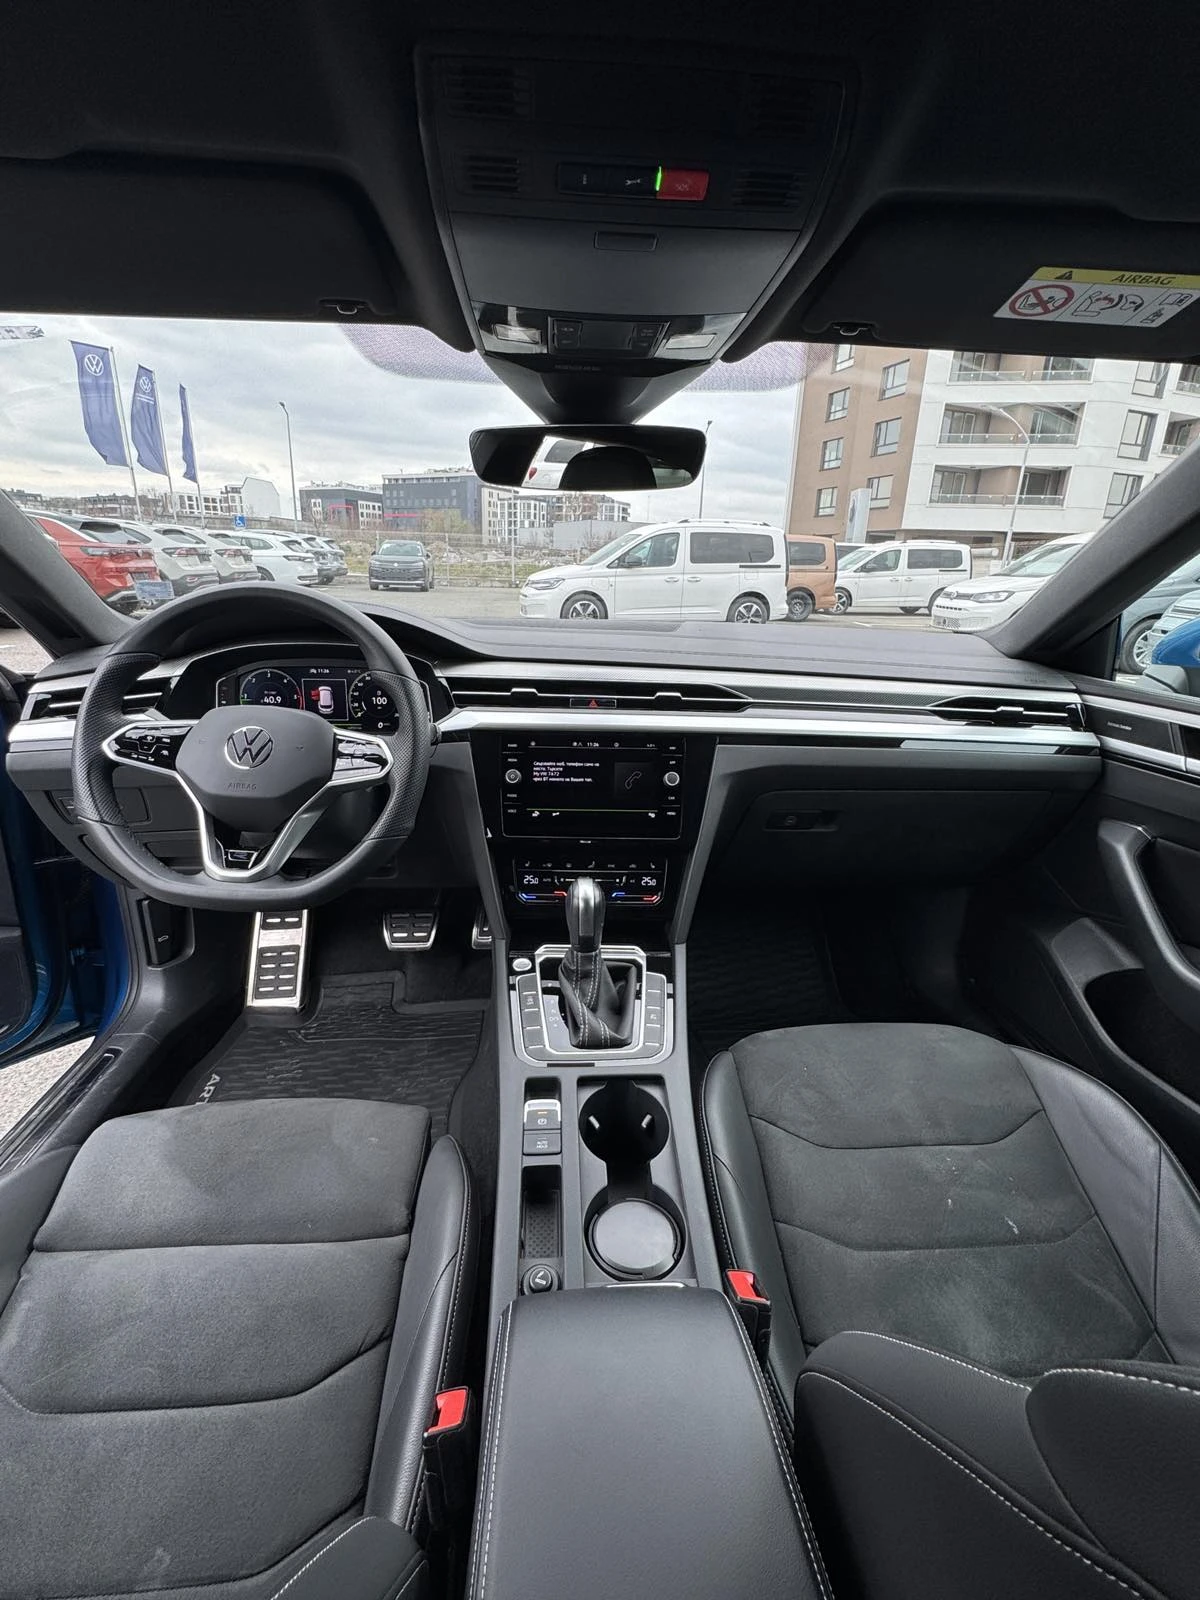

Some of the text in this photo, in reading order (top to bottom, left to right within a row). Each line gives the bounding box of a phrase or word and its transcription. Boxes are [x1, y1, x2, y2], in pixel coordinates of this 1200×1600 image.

[1111, 273, 1177, 286] AIRBAG
[263, 696, 282, 704] 40.9
[371, 697, 388, 705] 100
